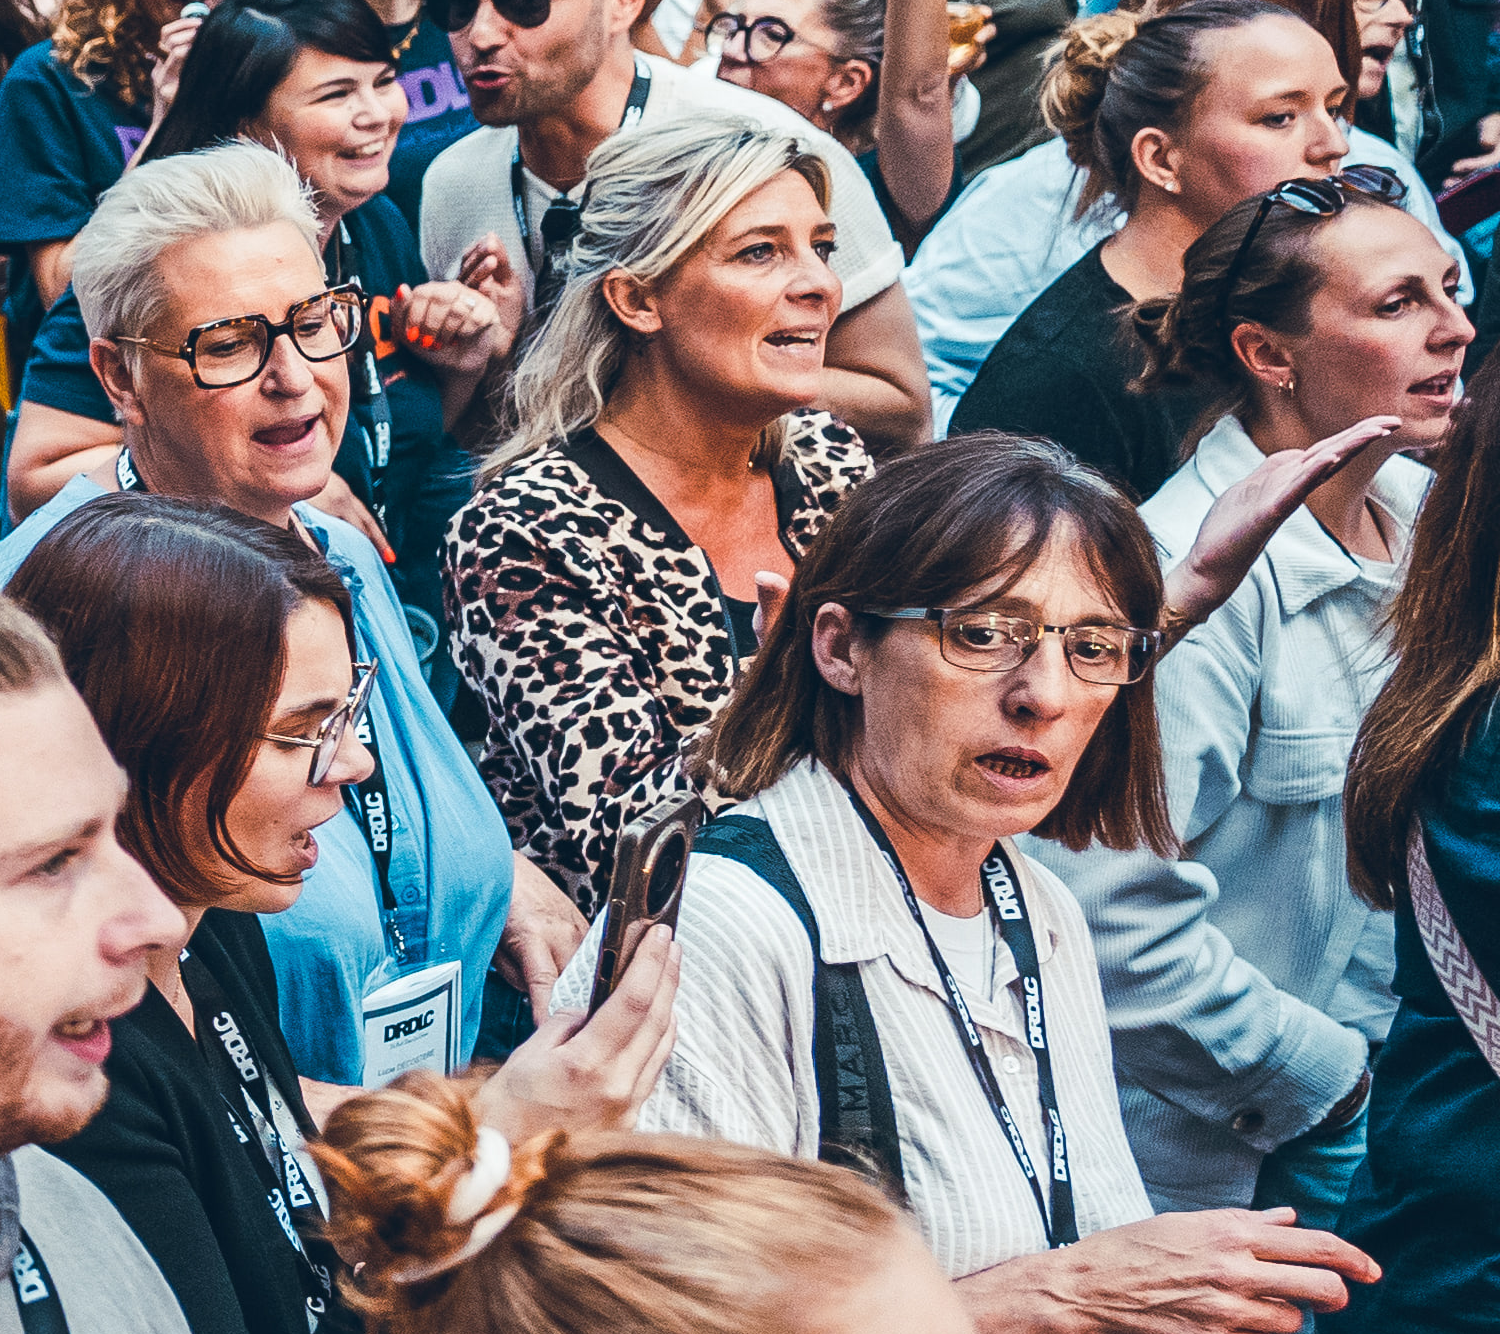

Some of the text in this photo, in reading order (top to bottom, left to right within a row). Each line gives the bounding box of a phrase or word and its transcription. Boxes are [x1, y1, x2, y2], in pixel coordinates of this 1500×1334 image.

[365, 790, 388, 852] DRDLC
[982, 856, 1023, 921] DRDLC
[213, 1011, 260, 1083] DRDLC
[383, 1010, 435, 1044] DRDLC
[1023, 976, 1046, 1050] DRDLC
[1000, 1105, 1036, 1179] DRDLC
[1048, 1107, 1068, 1182] DRDLC
